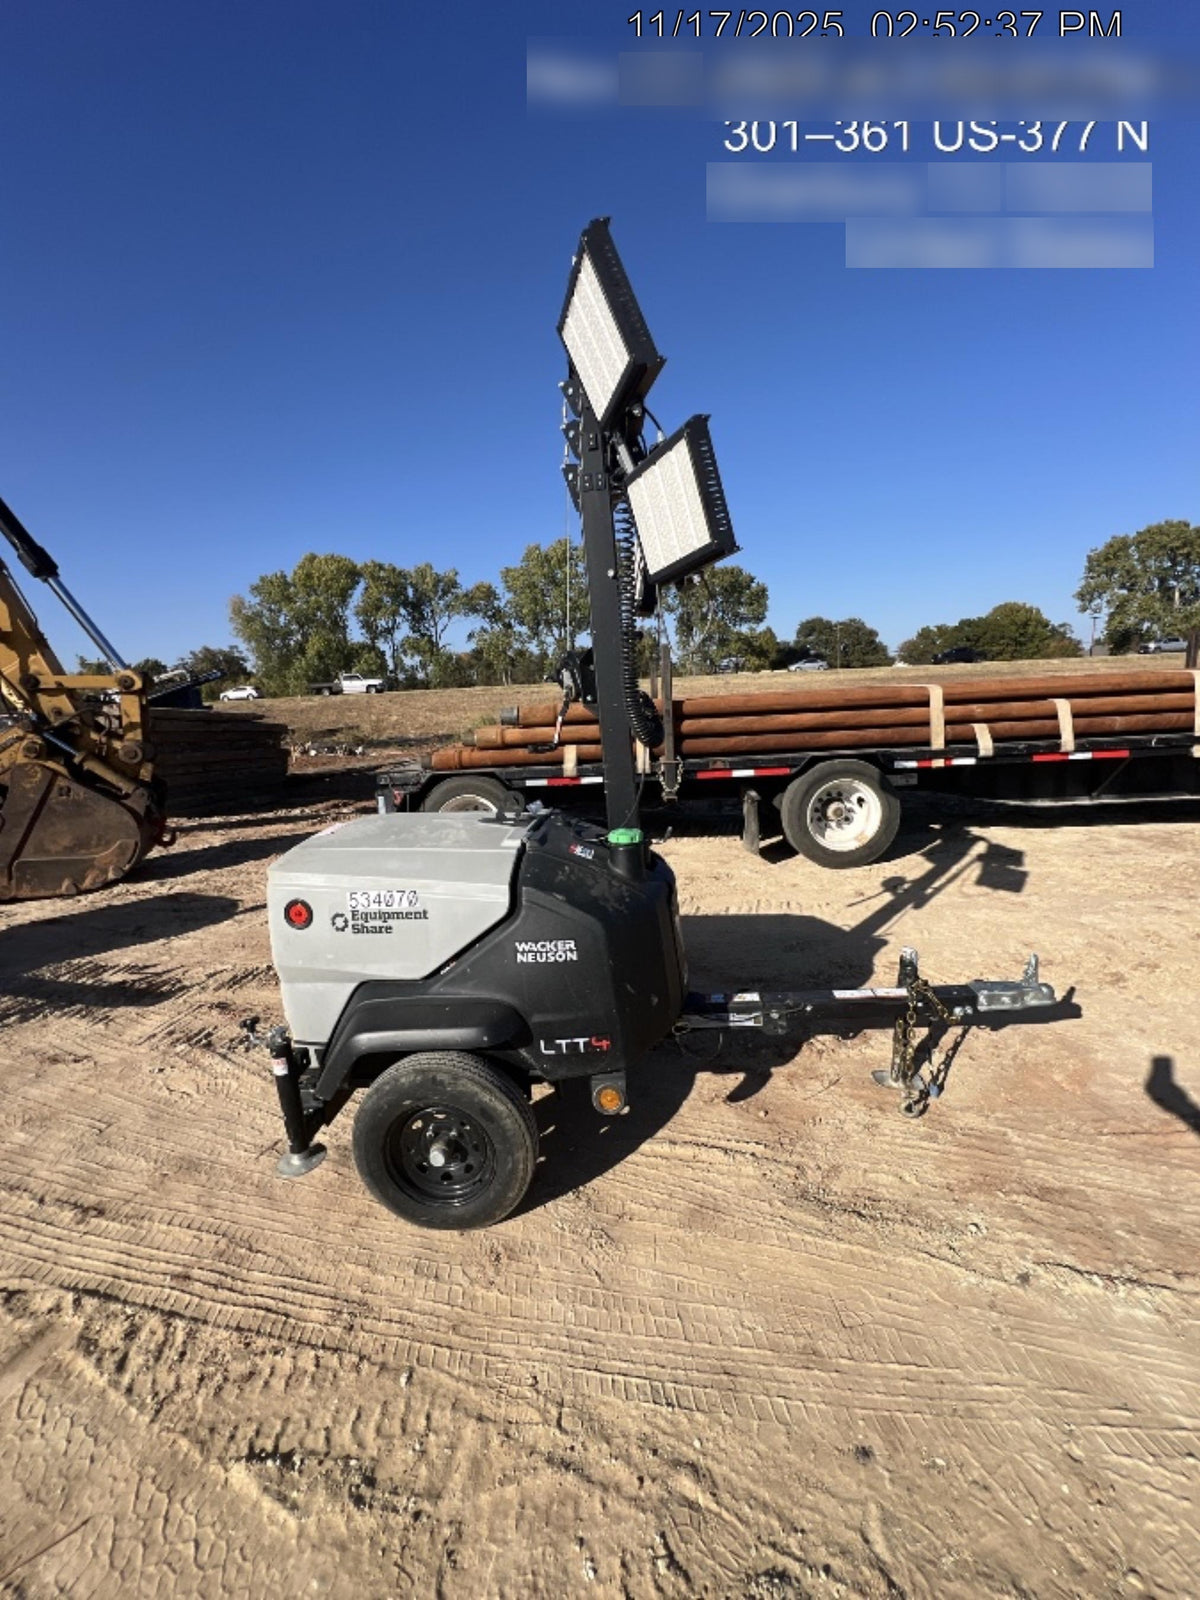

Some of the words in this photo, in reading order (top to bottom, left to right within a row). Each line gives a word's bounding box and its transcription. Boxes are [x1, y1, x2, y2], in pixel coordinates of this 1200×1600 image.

[349, 889, 419, 910] 534070
[350, 909, 429, 923] Equipment
[351, 922, 393, 934] Share
[515, 940, 576, 952] WACKER
[516, 950, 578, 963] NEUSON
[540, 1036, 611, 1055] LTT4
